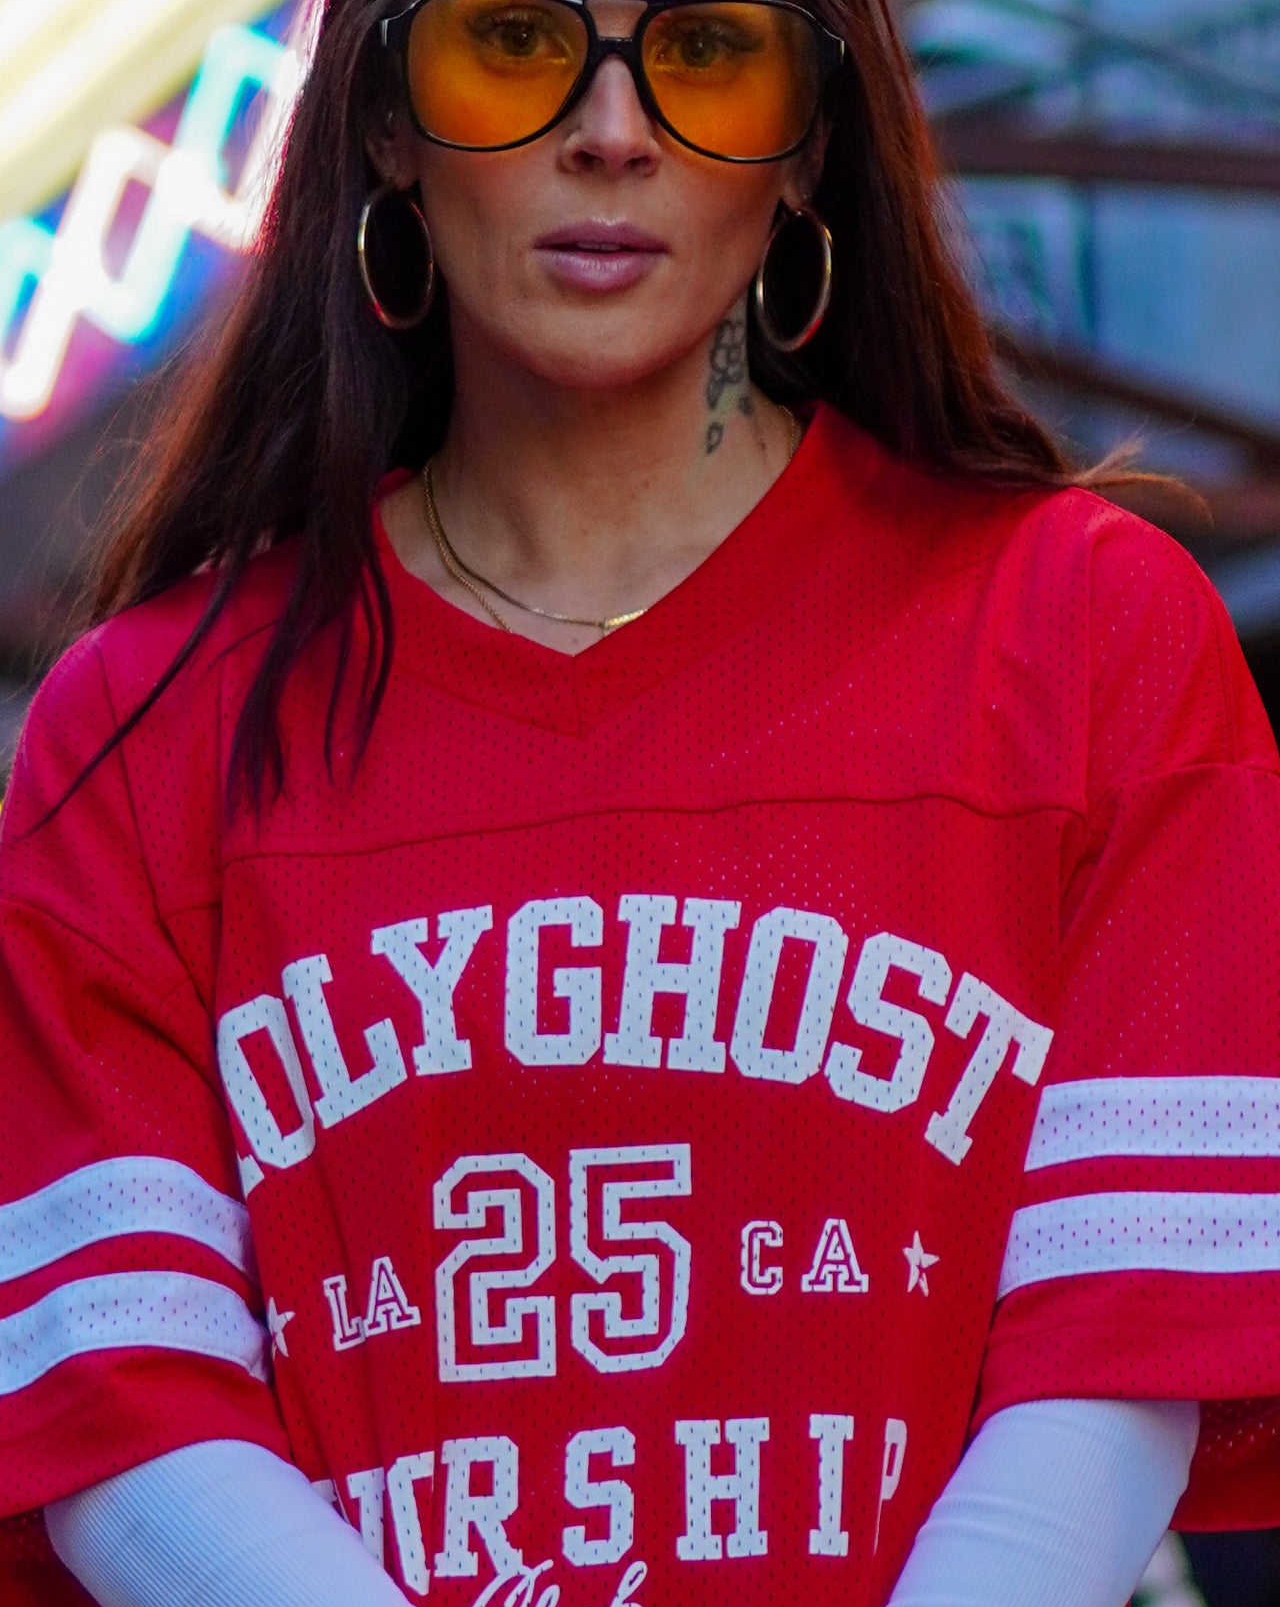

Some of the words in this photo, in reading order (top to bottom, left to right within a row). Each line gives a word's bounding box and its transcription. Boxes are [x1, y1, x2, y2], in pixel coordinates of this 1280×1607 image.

[217, 894, 1053, 1198] OLYGHOST
[322, 1256, 421, 1351] LA
[432, 1143, 692, 1383] 25
